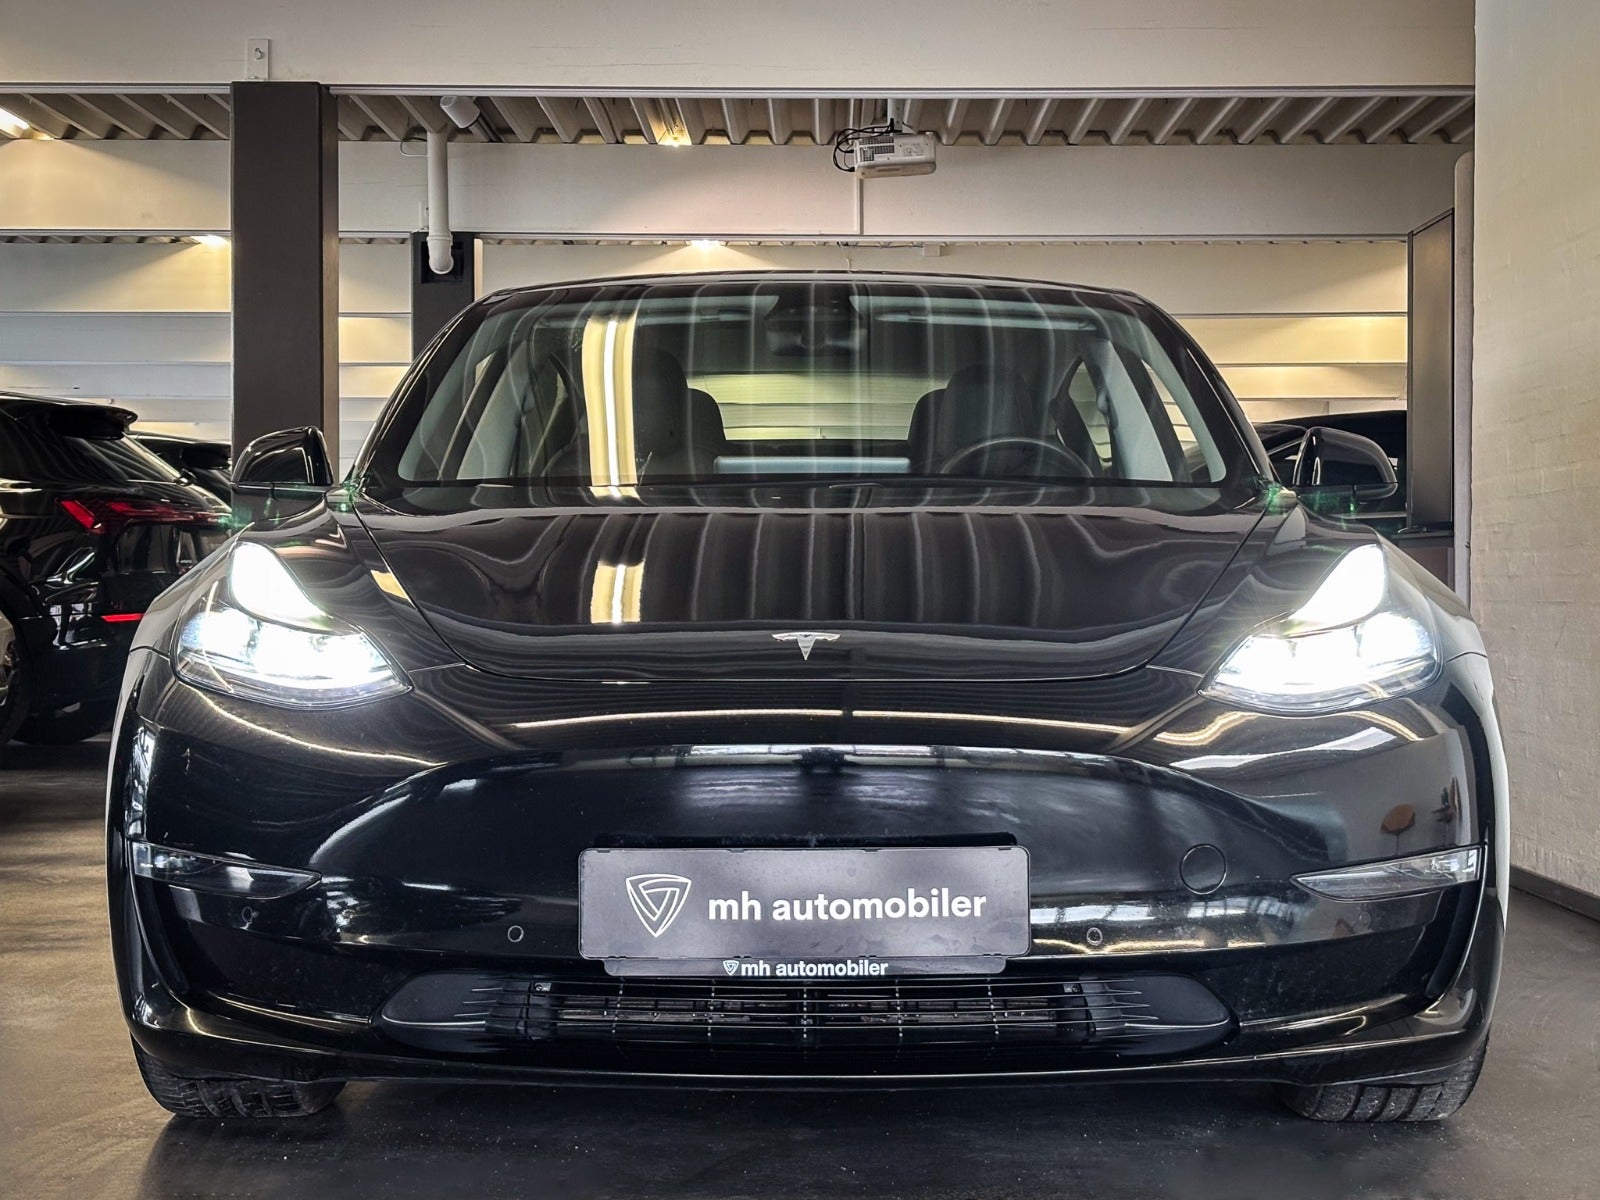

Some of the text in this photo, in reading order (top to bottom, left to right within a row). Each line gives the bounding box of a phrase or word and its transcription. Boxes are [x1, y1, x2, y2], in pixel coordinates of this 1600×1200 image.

[708, 888, 987, 921] mh automobiler
[741, 960, 888, 976] mh automobiler
